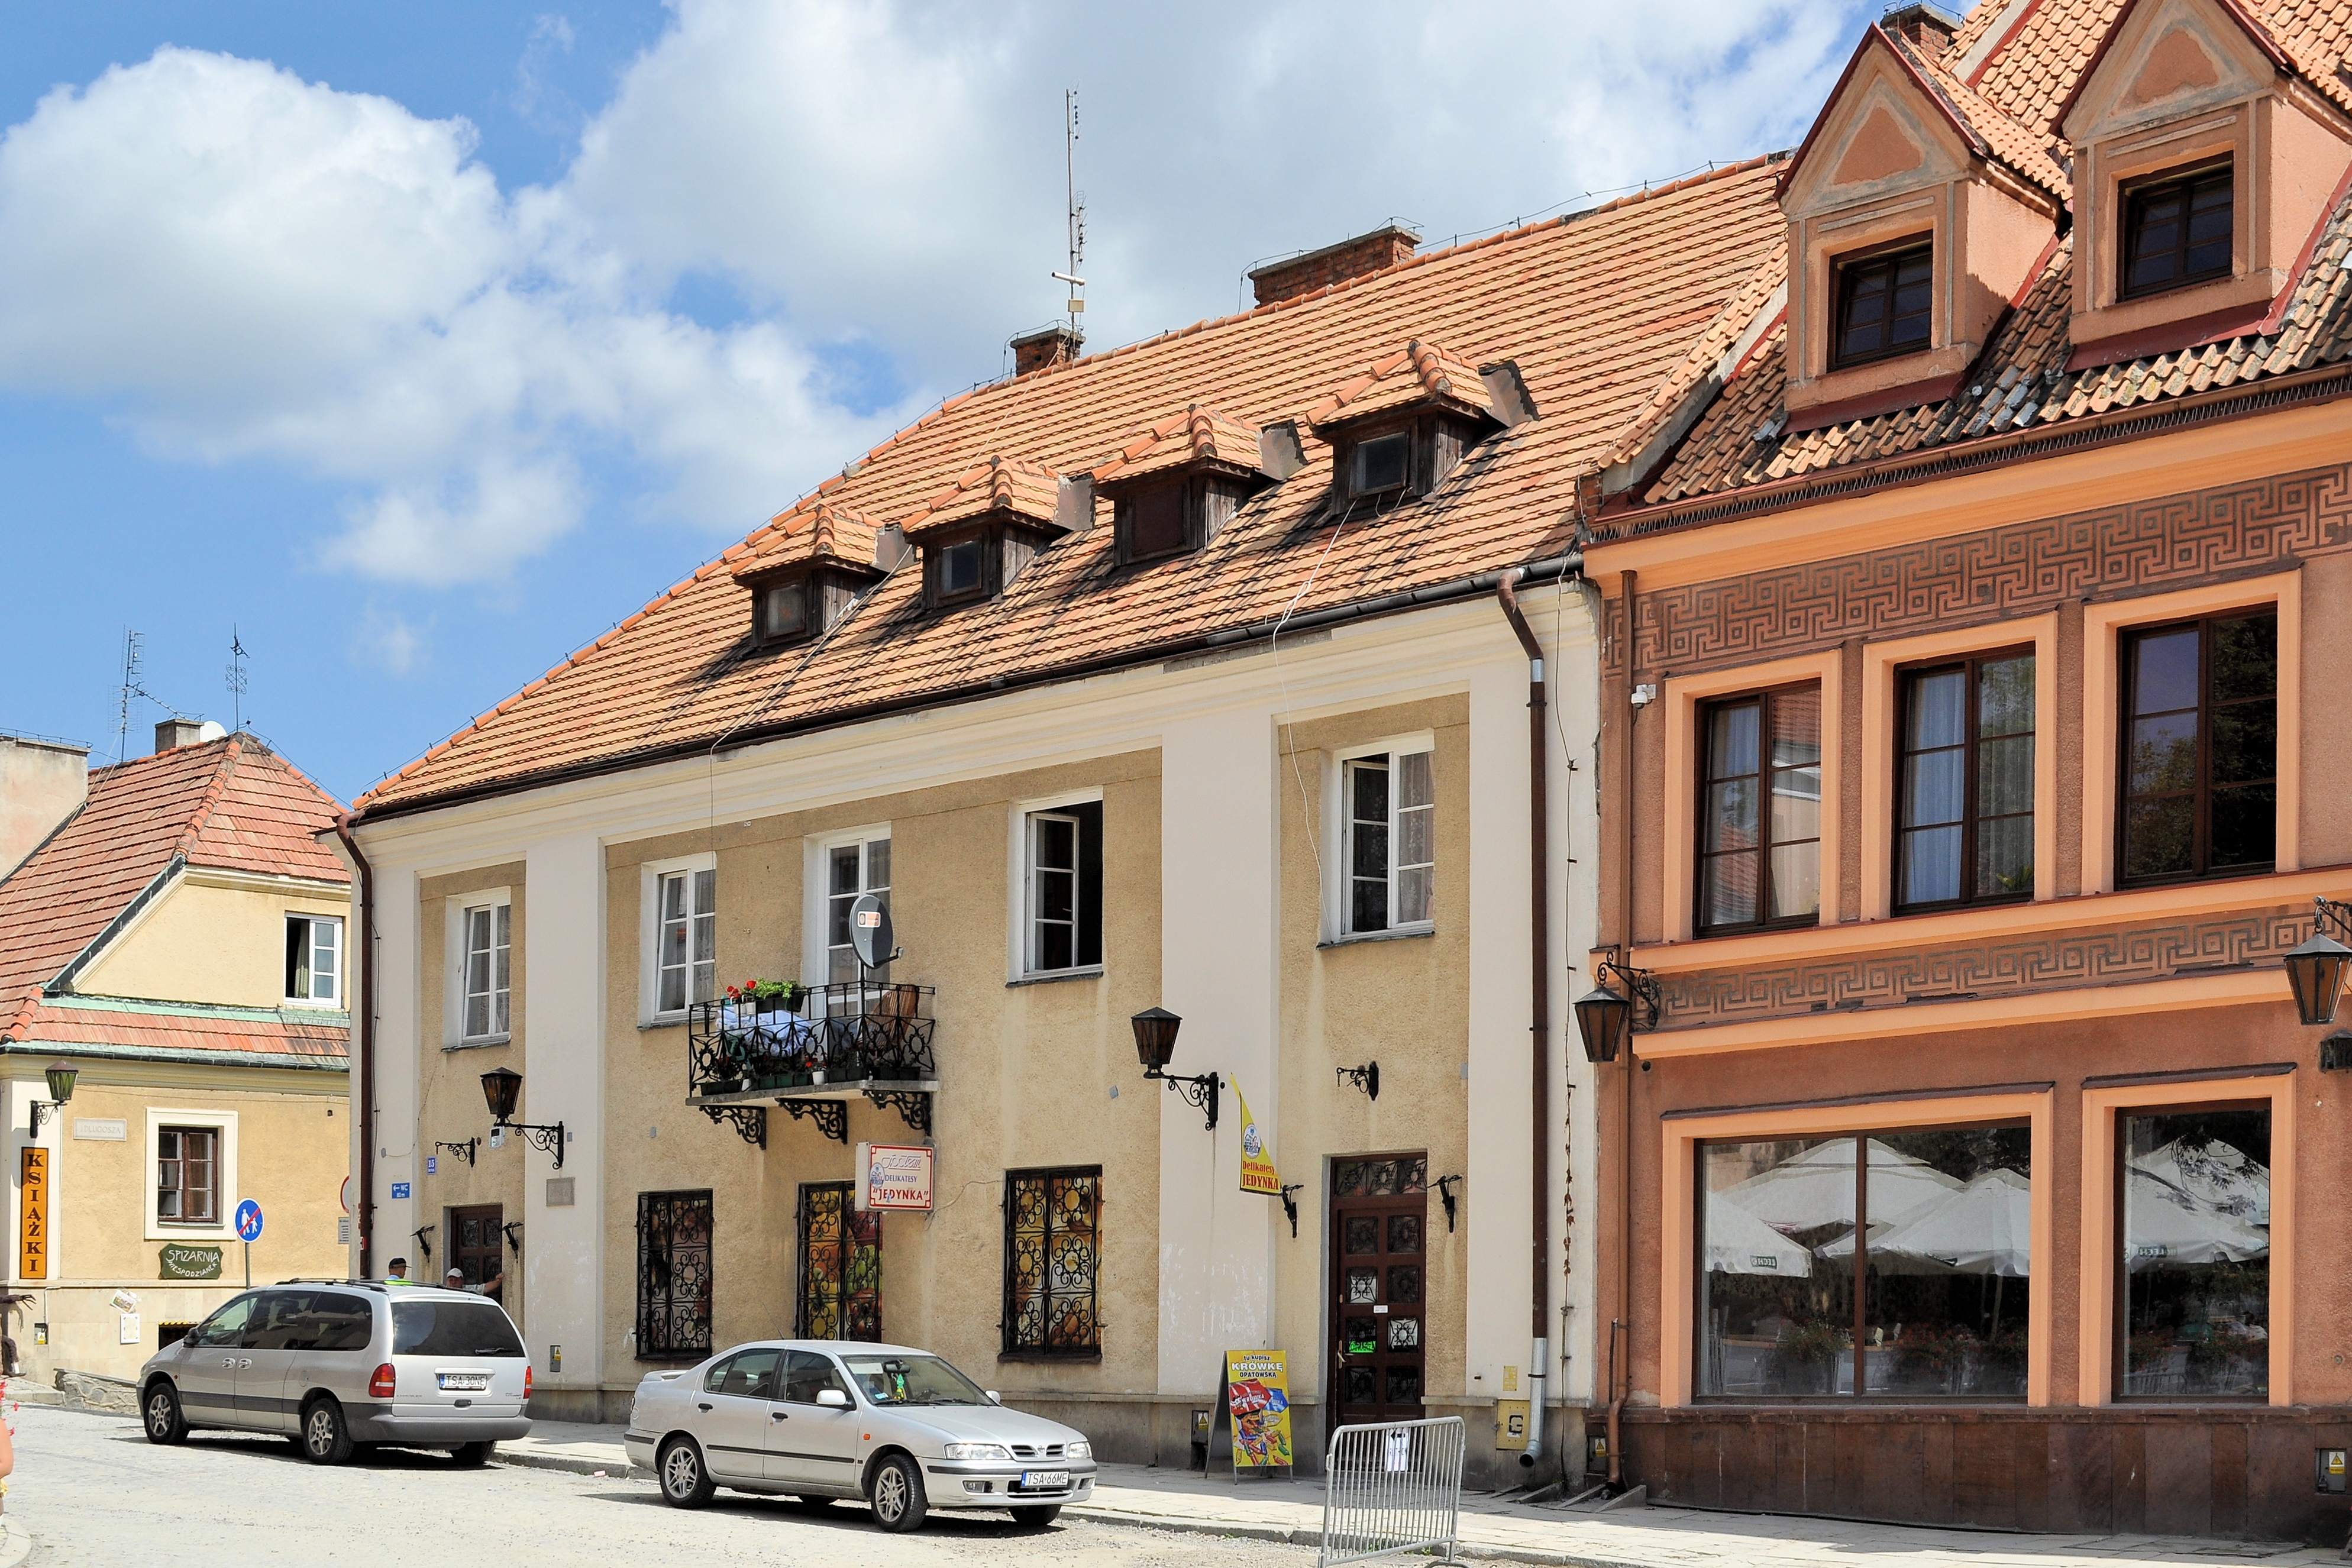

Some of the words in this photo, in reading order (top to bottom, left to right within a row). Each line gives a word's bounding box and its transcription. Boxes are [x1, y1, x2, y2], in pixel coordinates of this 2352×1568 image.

[428, 1159, 435, 1168] 15
[1243, 1160, 1275, 1175] Delikatesy
[1242, 1173, 1279, 1190] JEDYNKA
[25, 1154, 44, 1272] KSIĄŻKI
[1232, 1361, 1284, 1372] KRÓWKĘ
[446, 1375, 463, 1385] TSA
[466, 1376, 485, 1386] 30NE
[1028, 1473, 1044, 1485] TSA
[1046, 1472, 1068, 1484] 66ME
